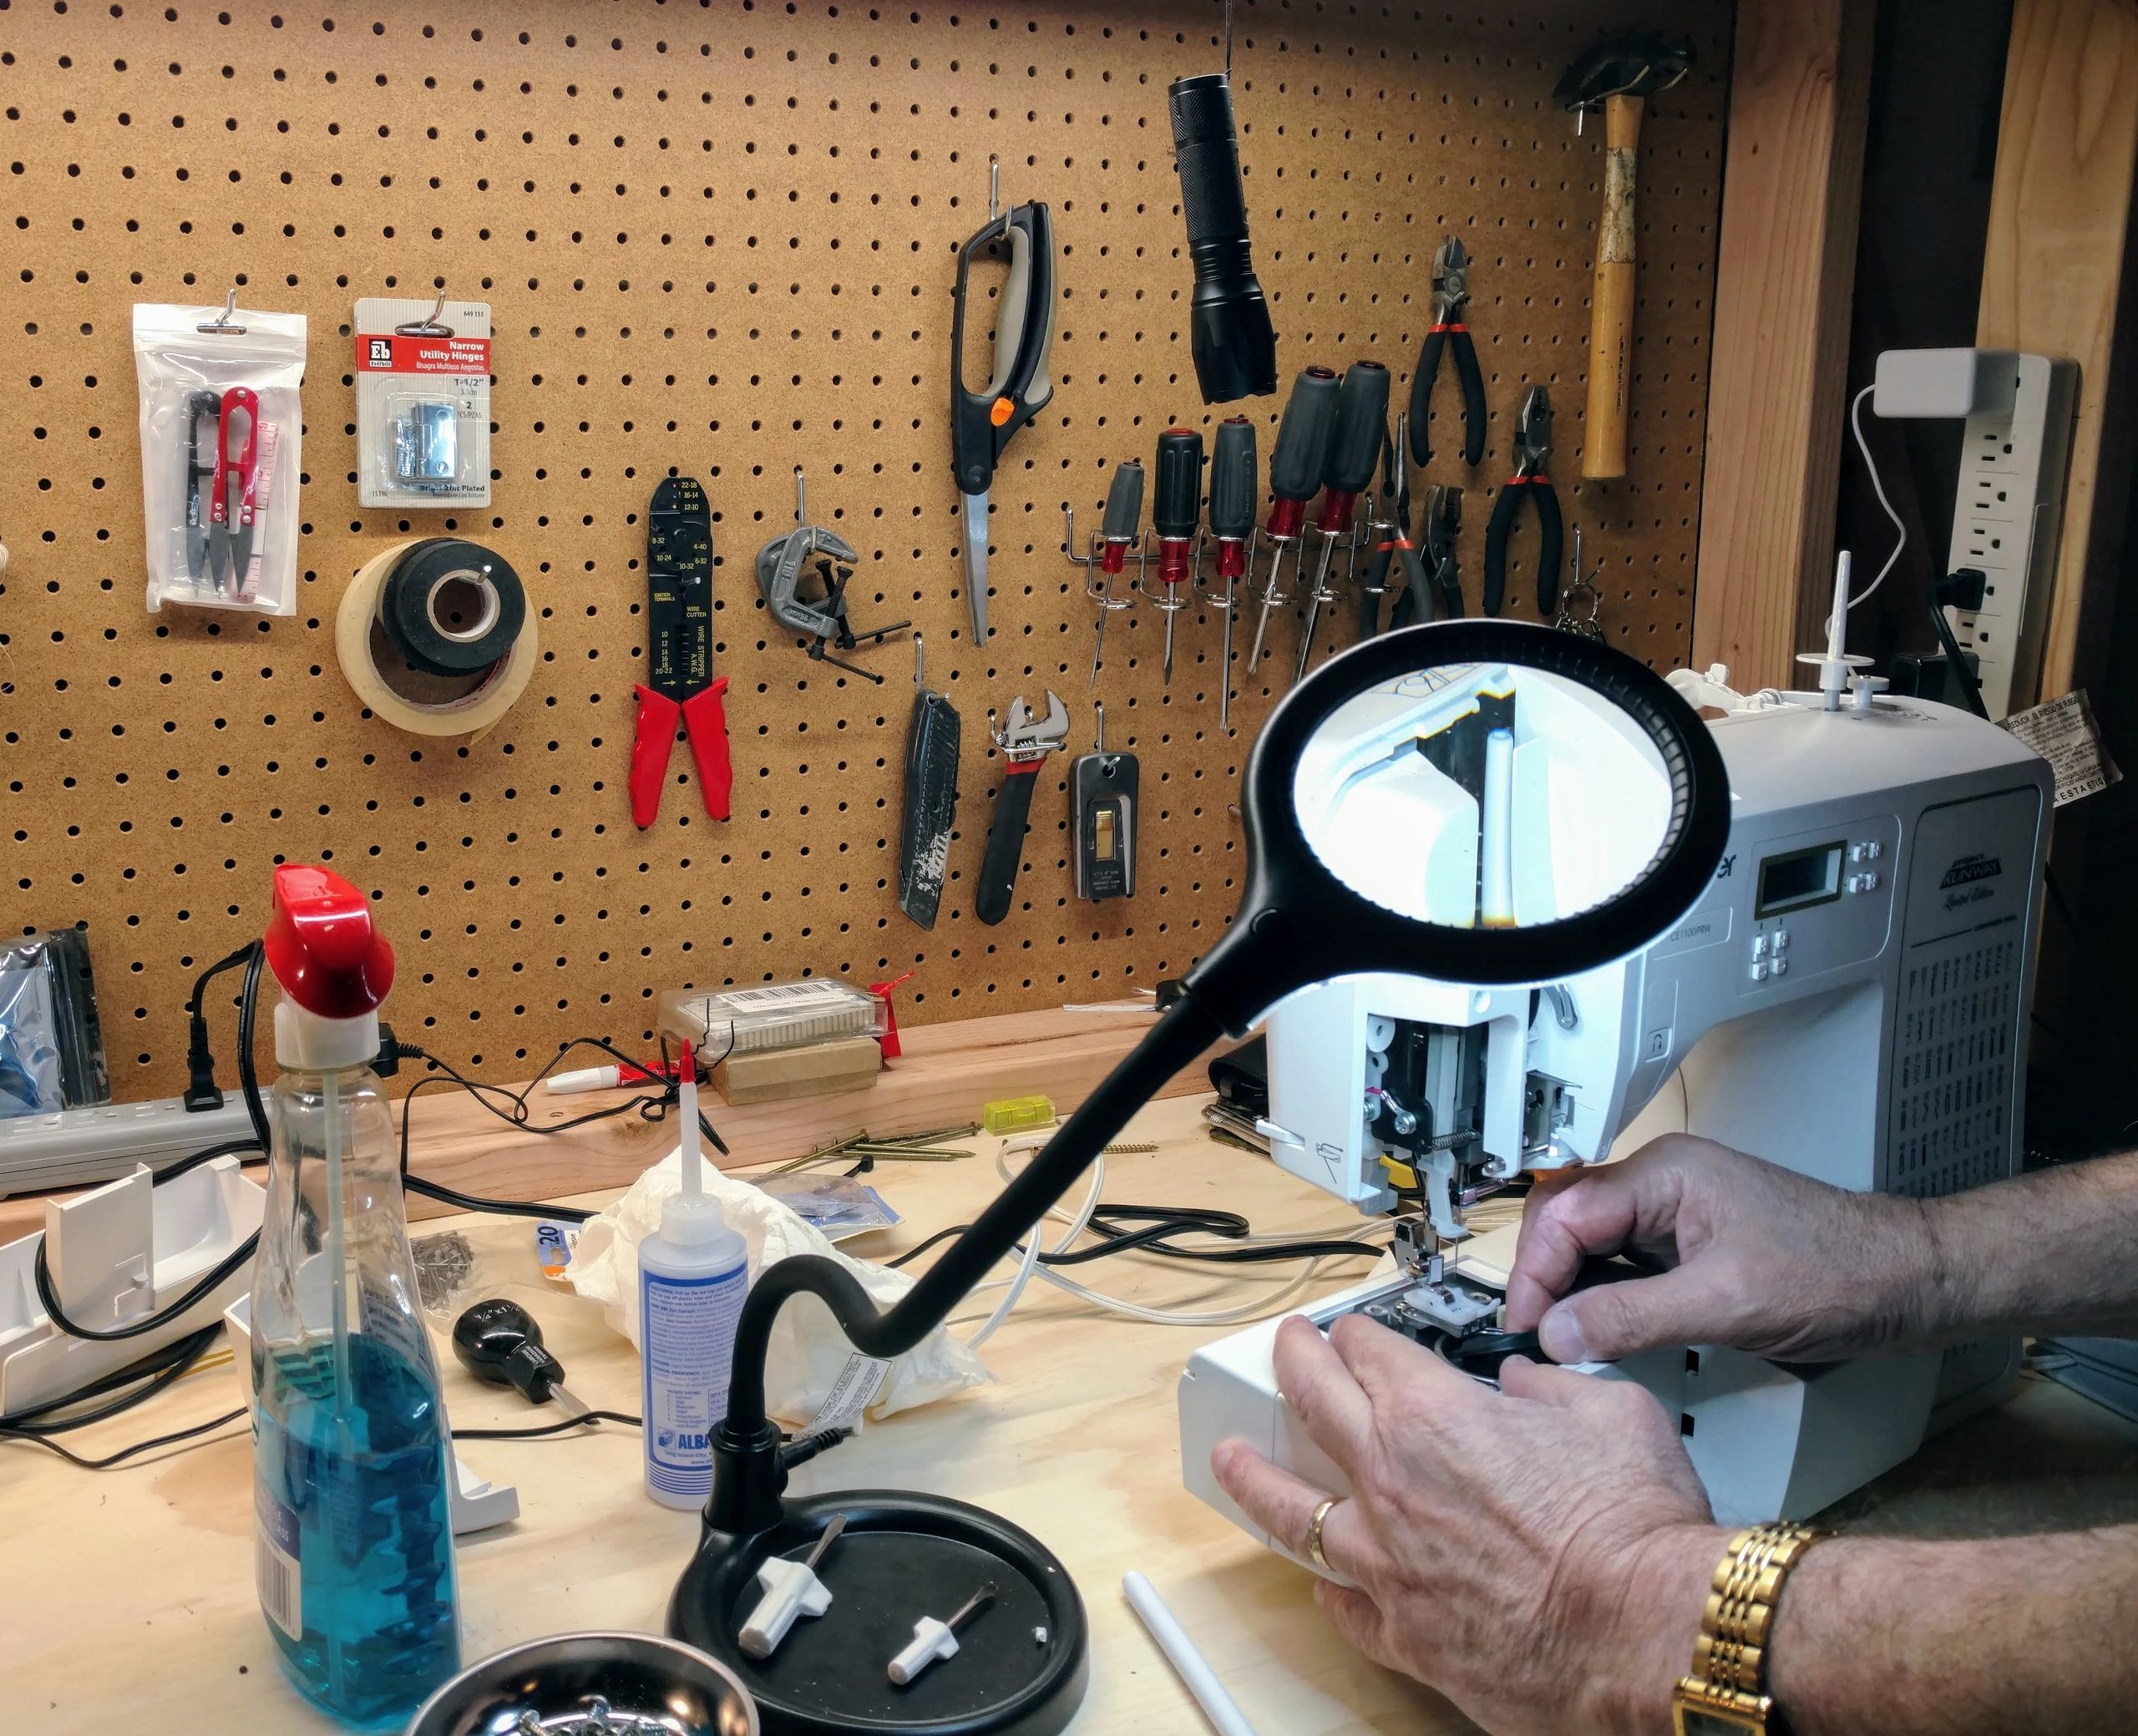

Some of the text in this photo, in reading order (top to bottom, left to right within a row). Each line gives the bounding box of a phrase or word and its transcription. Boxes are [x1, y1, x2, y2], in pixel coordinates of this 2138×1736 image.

[450, 342, 484, 351] Narrow
[420, 351, 484, 362] Utility Hinges
[2039, 707, 2056, 716] RIESGO
[2064, 697, 2078, 707] FUEGO
[2060, 785, 2086, 800] ESTA
[1671, 924, 1711, 941] CE1100PRW
[538, 1226, 560, 1245] 20
